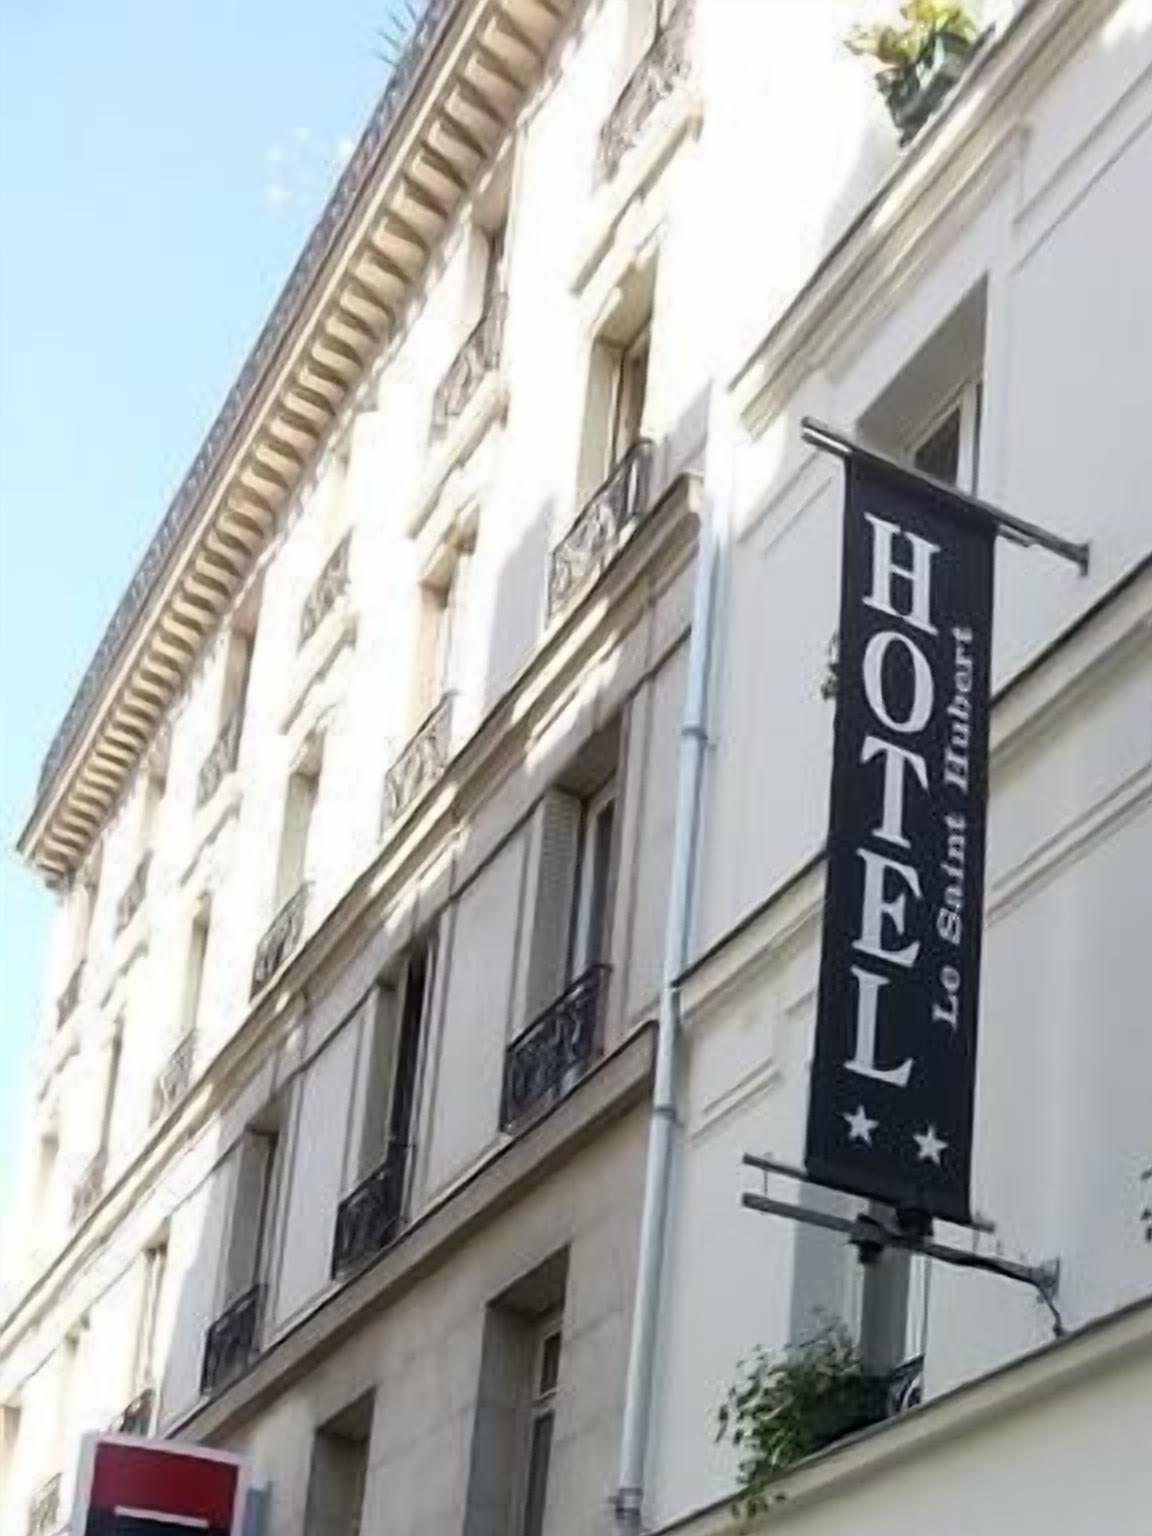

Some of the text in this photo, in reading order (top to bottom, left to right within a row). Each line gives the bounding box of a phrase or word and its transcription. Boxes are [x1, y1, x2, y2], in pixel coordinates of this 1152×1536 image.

[844, 511, 941, 1087] HOTEL
[932, 627, 973, 1033] Le Saint Hubert
